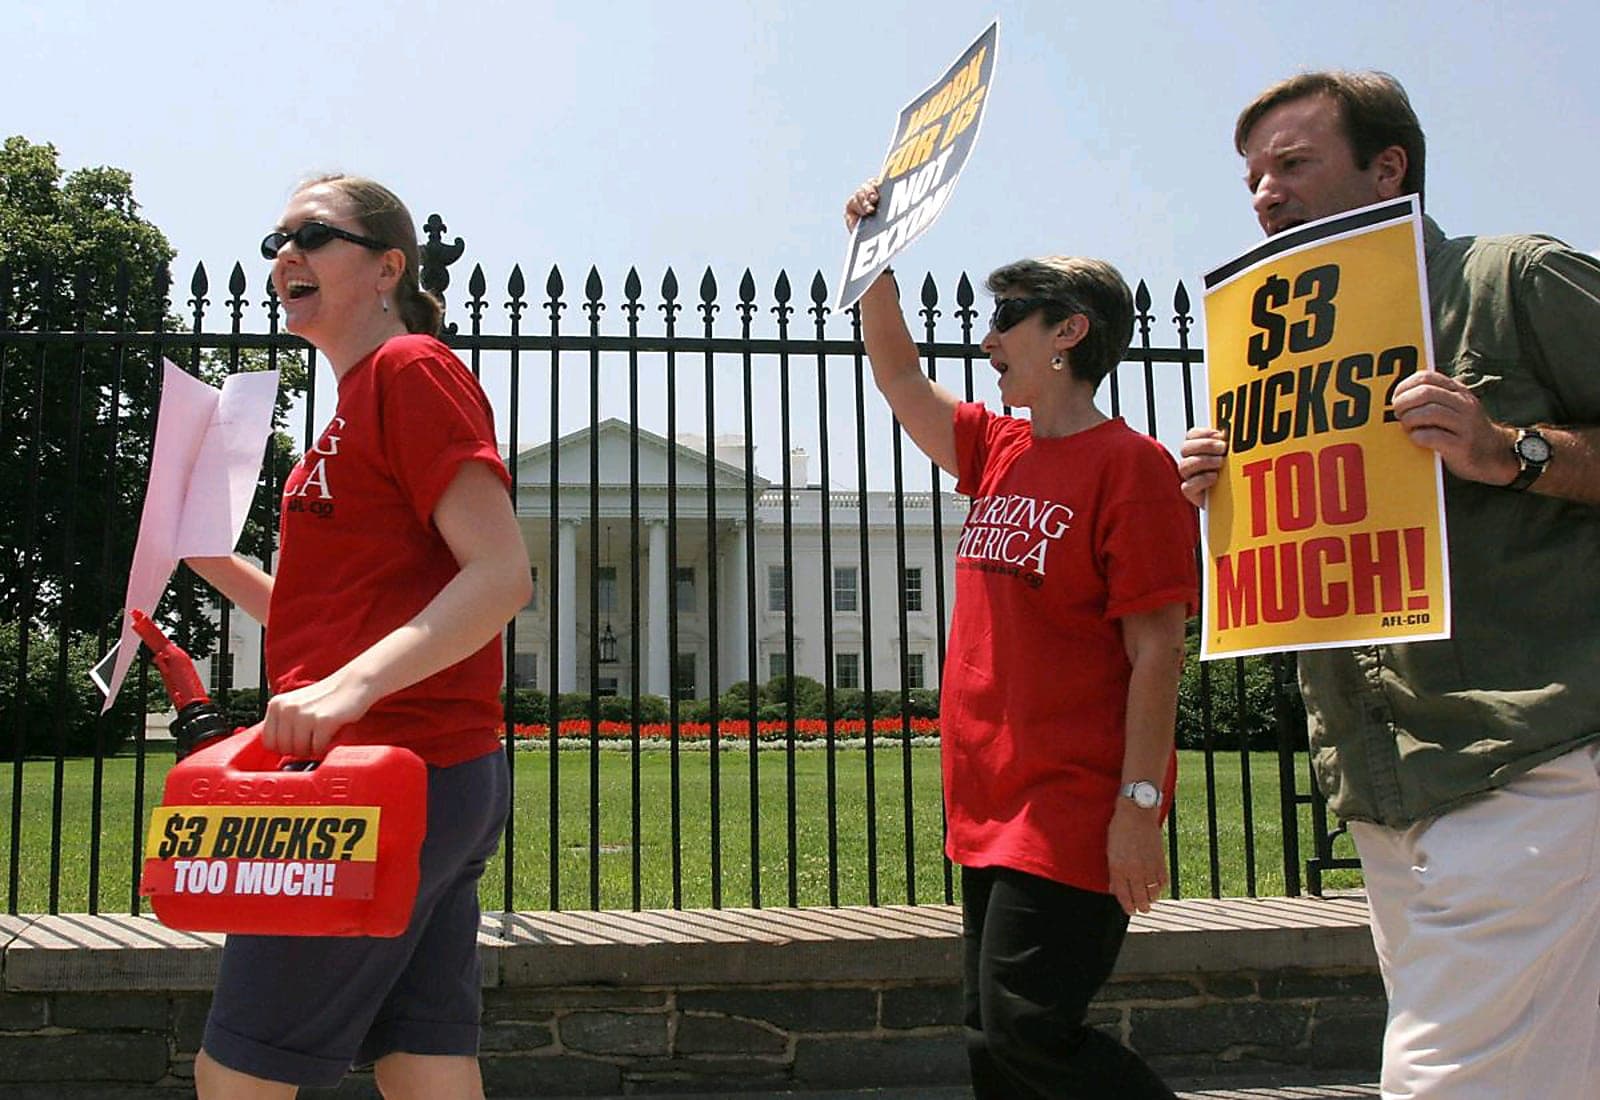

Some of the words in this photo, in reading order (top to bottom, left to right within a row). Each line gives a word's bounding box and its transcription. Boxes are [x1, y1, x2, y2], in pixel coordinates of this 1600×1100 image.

[879, 124, 943, 184] FOR
[940, 85, 986, 150] US
[899, 46, 986, 145] WORK
[886, 145, 955, 222] NOT
[1247, 263, 1340, 371] $3
[1216, 345, 1418, 456] BUCKS?
[1243, 442, 1367, 537] TOO
[1216, 527, 1429, 631] MUCH!
[1382, 613, 1430, 628] AFL-CIO
[191, 777, 349, 799] GASOLNE
[159, 813, 208, 860] $3
[212, 816, 368, 861] BUCKS?
[174, 861, 228, 894] TOO
[234, 861, 336, 896] MUCH!
